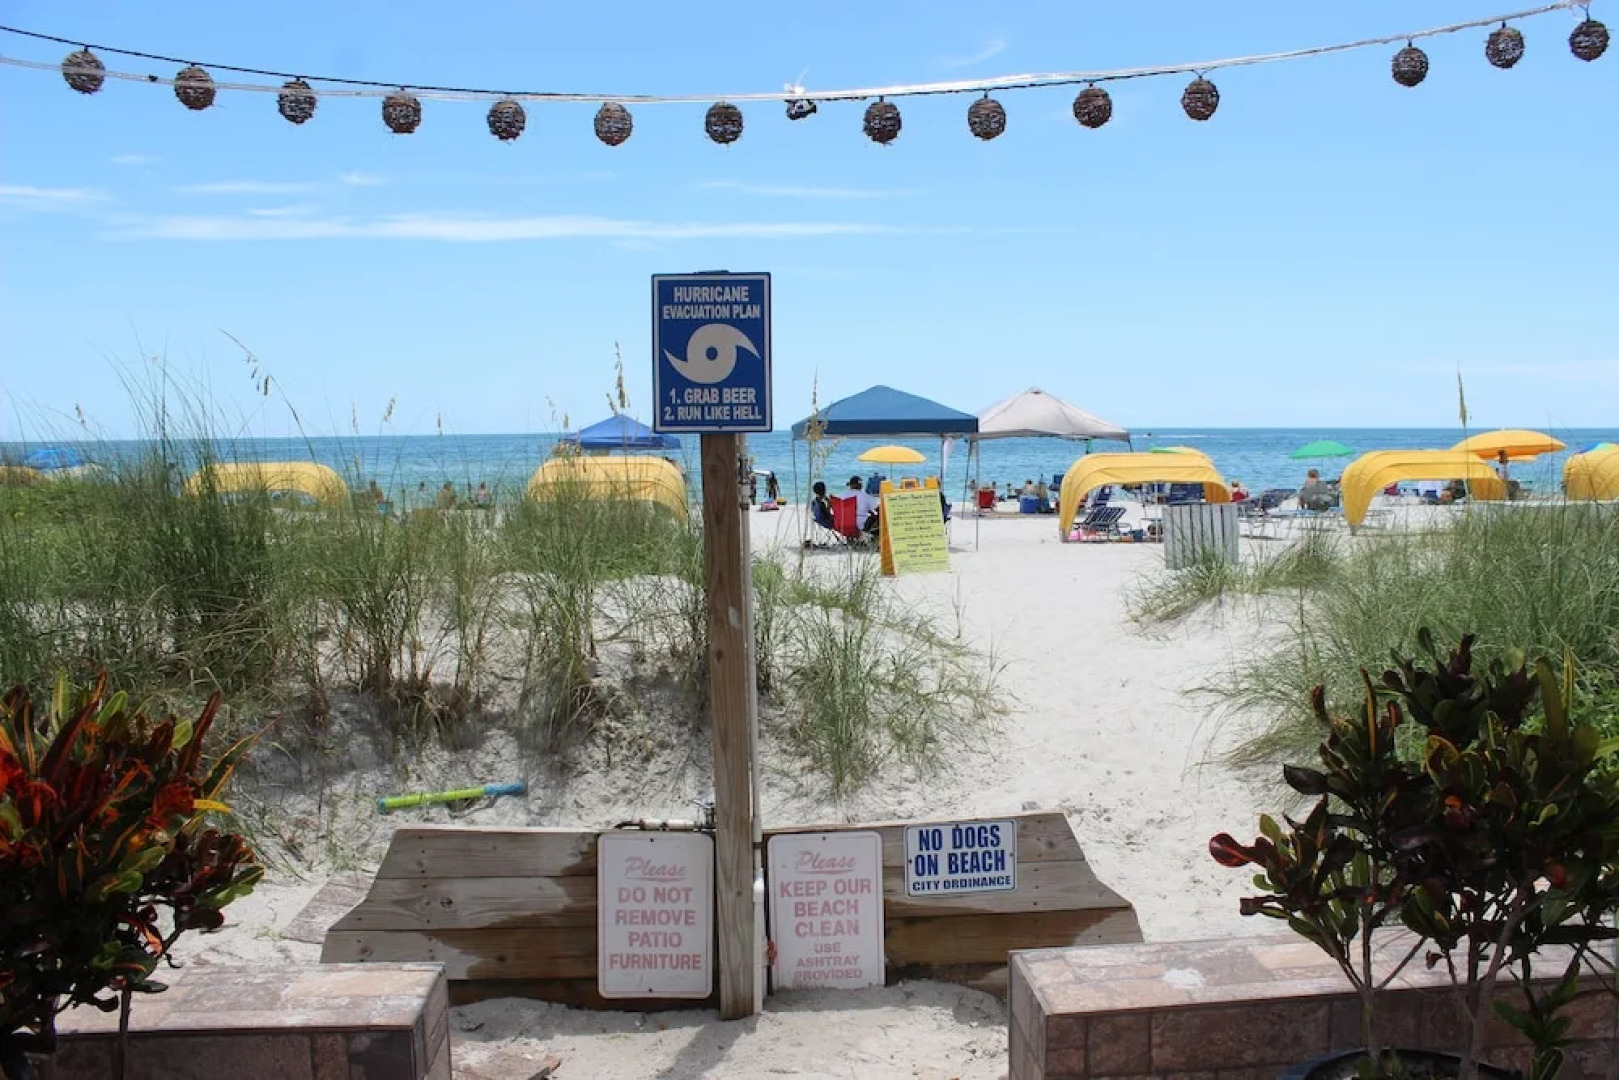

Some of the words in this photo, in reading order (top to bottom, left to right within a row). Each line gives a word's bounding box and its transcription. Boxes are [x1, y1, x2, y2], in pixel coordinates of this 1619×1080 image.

[674, 286, 749, 303] HURRICANE
[663, 304, 730, 319] EVACUATION
[733, 304, 761, 319] PLAN
[669, 388, 681, 404] 1.
[684, 388, 719, 404] GRAB
[722, 388, 757, 404] BEER
[664, 406, 675, 420] 2.
[678, 406, 700, 420] RUN
[705, 406, 730, 420] LIKE
[733, 405, 762, 420] HELL
[918, 828, 943, 851] NO
[951, 825, 1001, 849] DOGS
[624, 856, 688, 878] Please
[795, 850, 857, 870] Please
[914, 854, 938, 876] ON
[948, 849, 1005, 874] BEACH
[779, 880, 827, 898] KEEP
[833, 878, 872, 895] OUR
[912, 880, 940, 891] CITY
[943, 876, 1011, 889] ORDINANCE
[617, 887, 647, 903] DO
[653, 887, 693, 903] NOT
[794, 900, 859, 917] BEACH
[615, 909, 696, 926] REMOVE
[795, 919, 861, 938] CLEAN
[627, 931, 683, 948] PATIO
[813, 942, 842, 954] USE
[609, 953, 702, 970] FURNITURE
[796, 954, 860, 967] ASHTRAY
